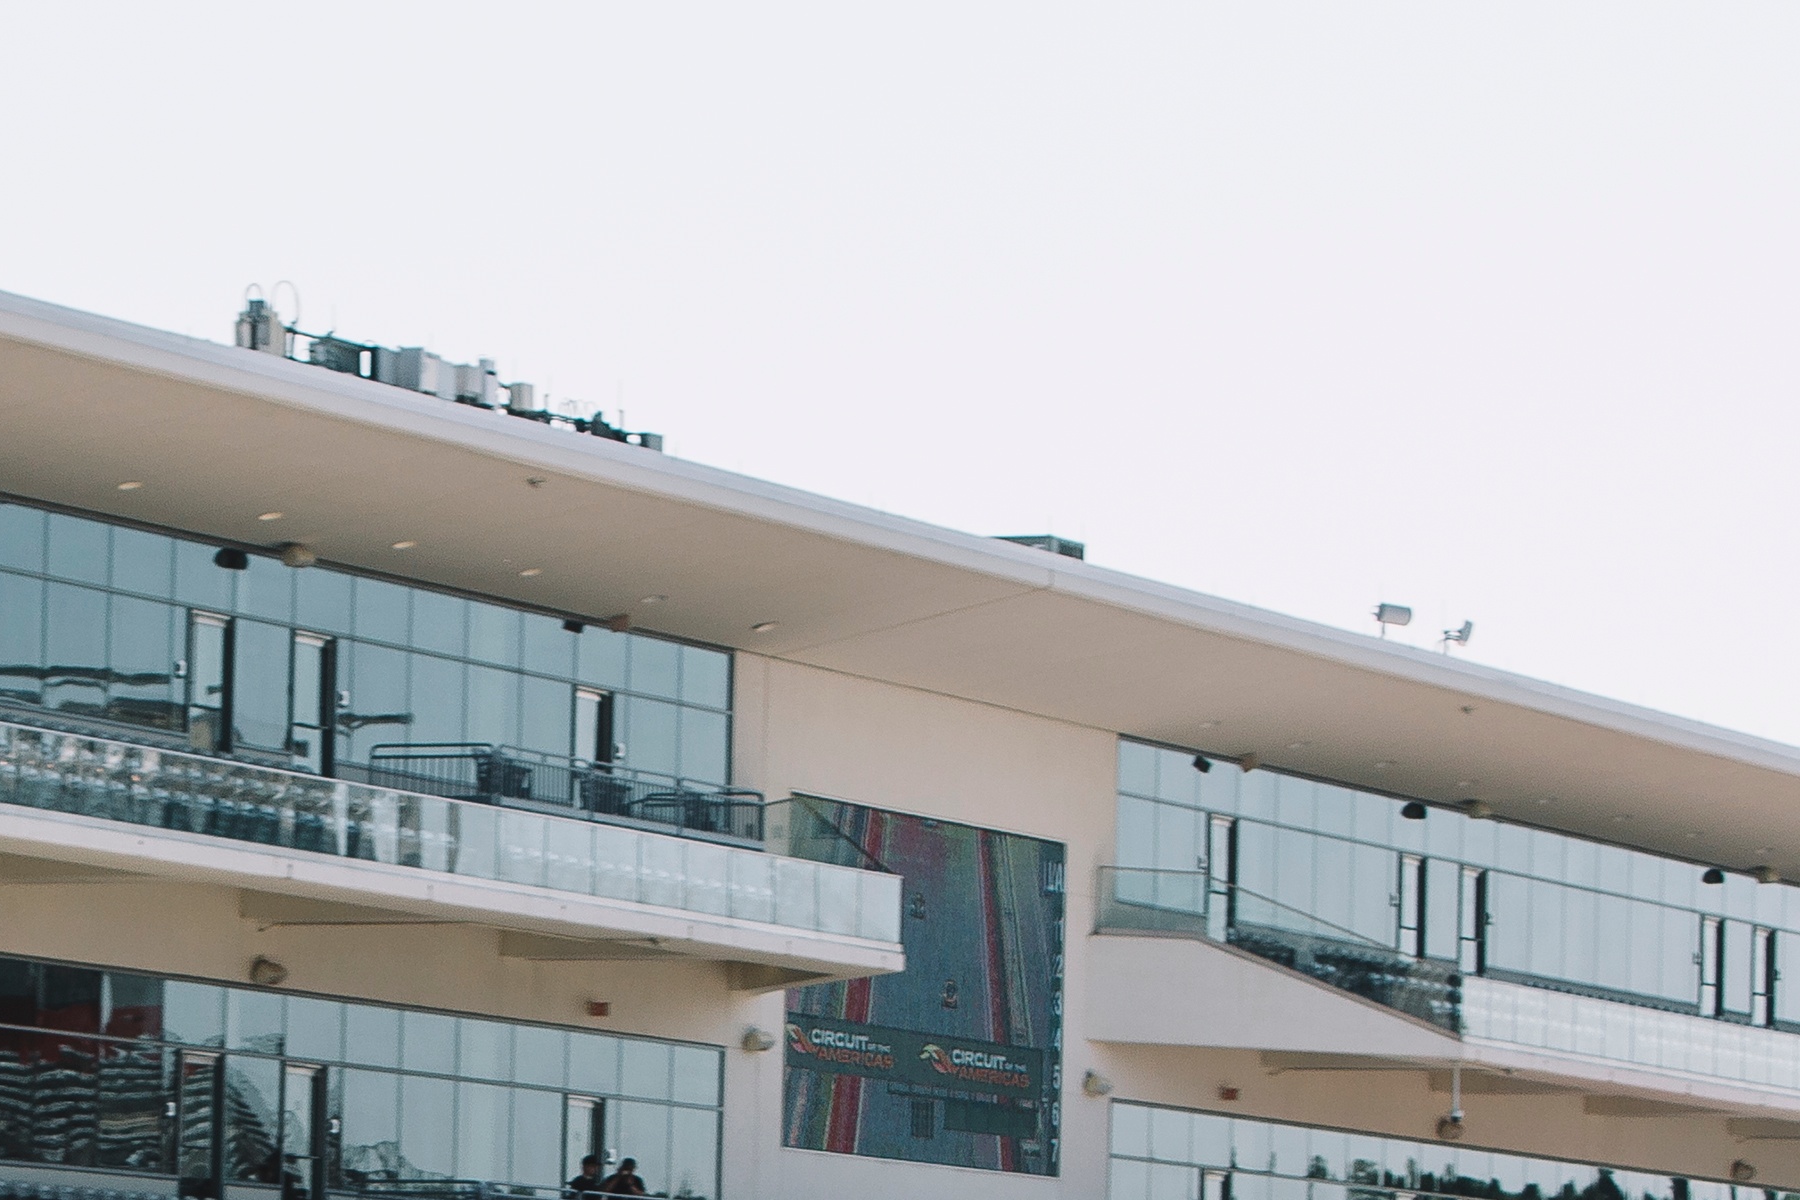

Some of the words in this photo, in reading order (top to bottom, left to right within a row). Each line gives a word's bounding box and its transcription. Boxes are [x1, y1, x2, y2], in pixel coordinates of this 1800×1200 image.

[810, 1028, 869, 1049] CIRCUIT
[816, 1049, 894, 1070] AMERICAS
[952, 1049, 1007, 1069] CIRCUIT
[958, 1067, 1031, 1088] AMERICAS
